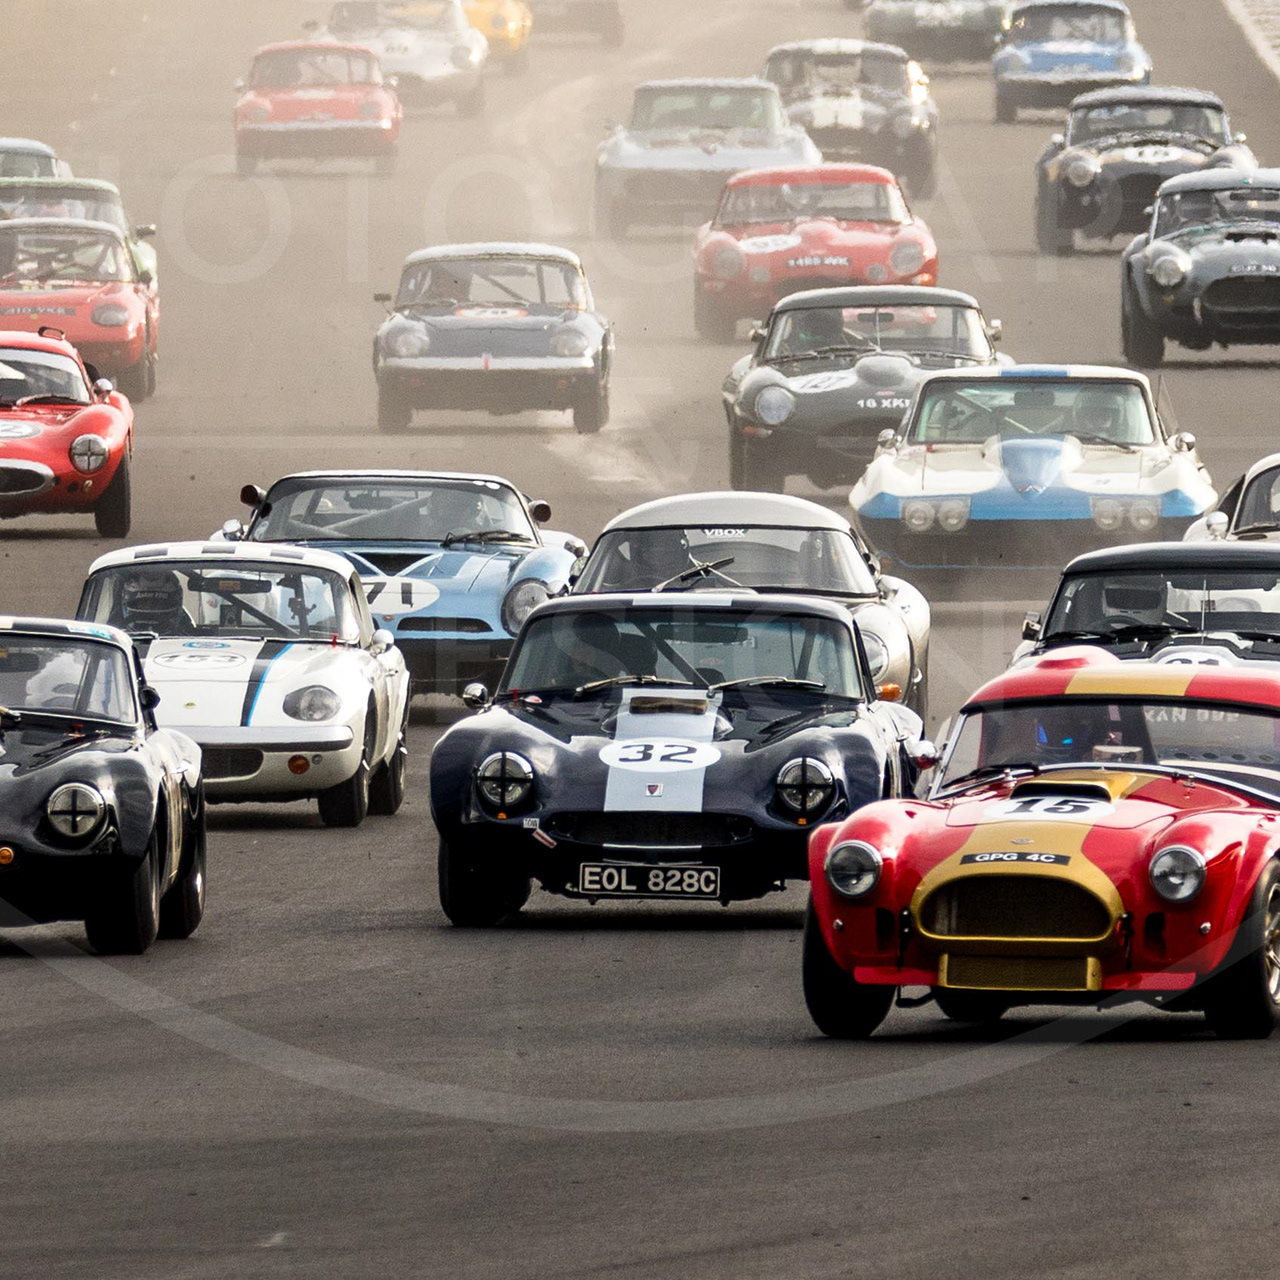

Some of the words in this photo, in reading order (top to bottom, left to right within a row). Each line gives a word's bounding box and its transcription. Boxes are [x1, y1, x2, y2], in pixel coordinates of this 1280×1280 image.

[704, 528, 745, 537] VBOX
[361, 581, 414, 607] 71
[619, 744, 699, 764] 32
[1002, 796, 1095, 815] 15
[975, 852, 1019, 862] GPG
[1027, 852, 1056, 862] 4C
[584, 868, 637, 890] EOL
[648, 869, 715, 892] 828C
